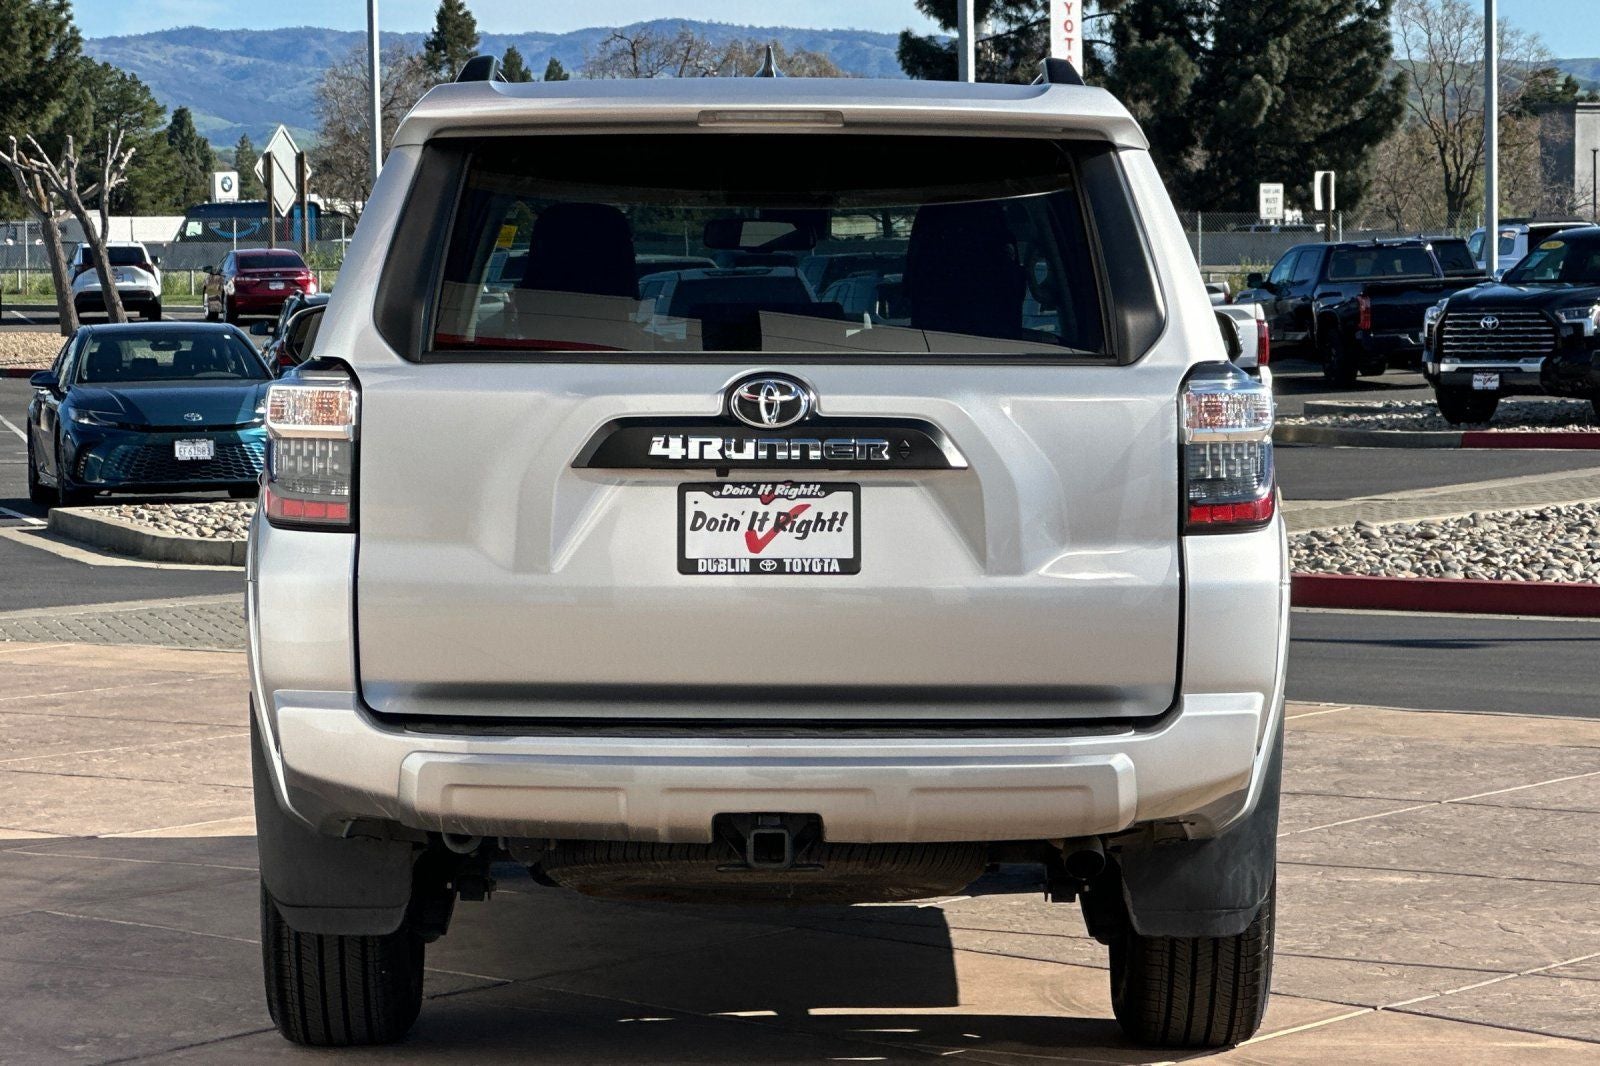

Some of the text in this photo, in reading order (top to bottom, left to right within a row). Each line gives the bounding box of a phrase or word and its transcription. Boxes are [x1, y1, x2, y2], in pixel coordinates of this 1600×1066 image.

[721, 484, 821, 500] Doin' It Right!
[689, 510, 849, 540] Doin' It Right!
[697, 558, 840, 573] DUBLIN TOYOTA
